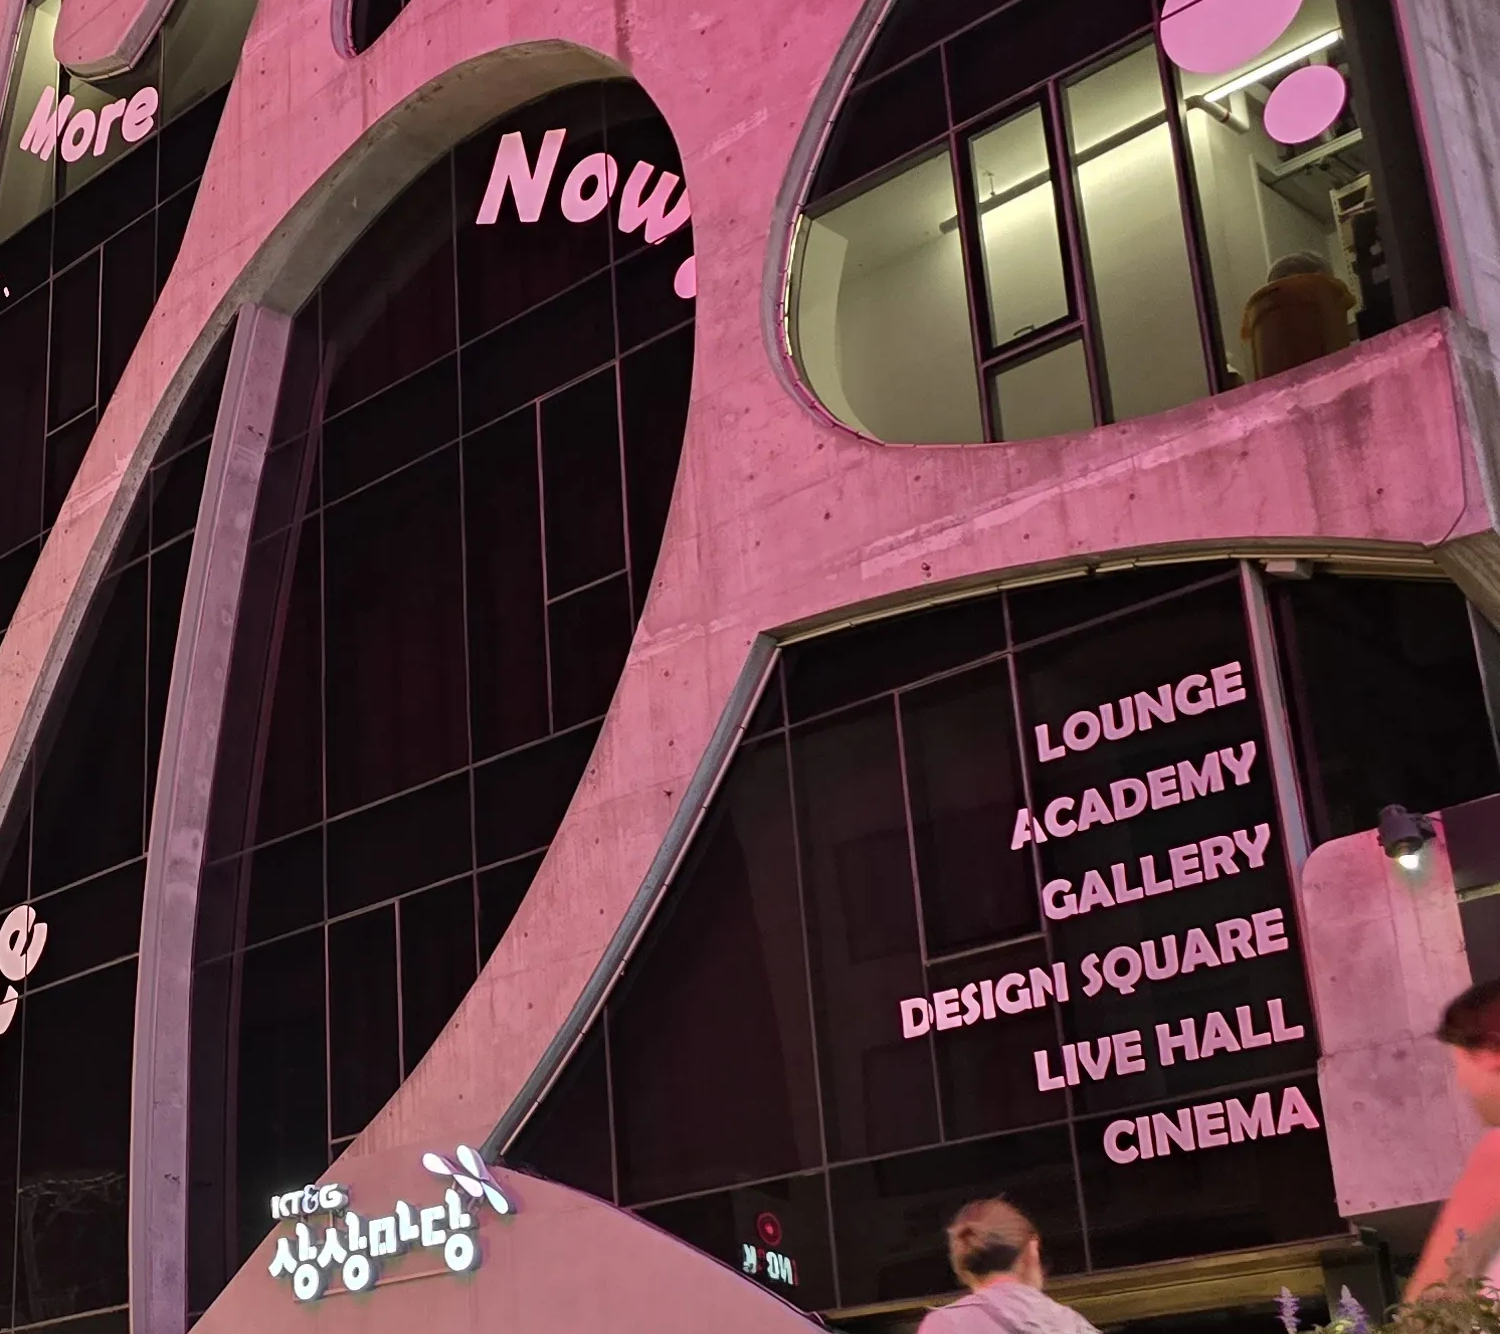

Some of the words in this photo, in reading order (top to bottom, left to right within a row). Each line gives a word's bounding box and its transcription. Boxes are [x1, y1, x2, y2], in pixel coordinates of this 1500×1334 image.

[19, 84, 159, 164] More
[475, 128, 691, 246] Now
[1034, 661, 1246, 763] LOUNGE
[1010, 741, 1257, 851] ACADEMY
[1041, 822, 1271, 920] GALLERY
[899, 961, 1069, 1039] DESIGN
[1081, 908, 1289, 998] SQUARE
[1033, 1029, 1146, 1092] LIVE
[1155, 998, 1304, 1067] HALL
[1103, 1086, 1319, 1164] CINEMA
[268, 1188, 476, 1301] 상상마당
[270, 1183, 345, 1220] KT&G
